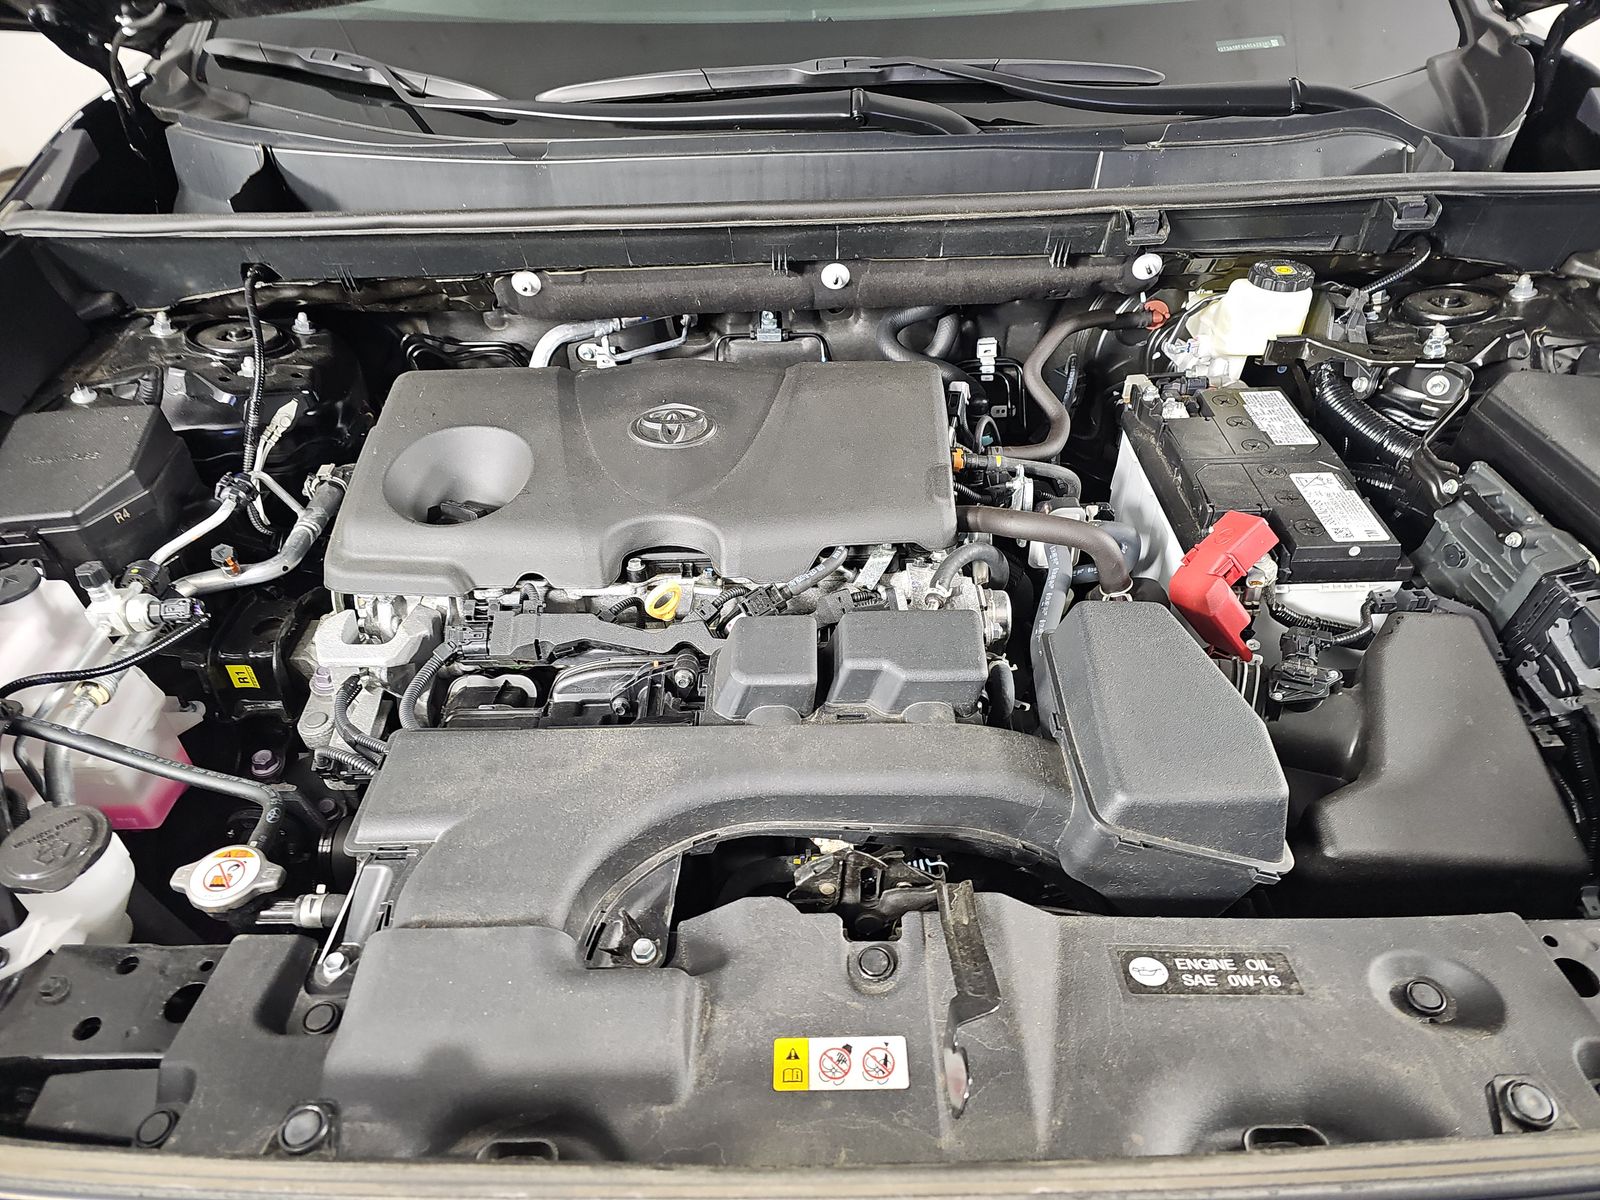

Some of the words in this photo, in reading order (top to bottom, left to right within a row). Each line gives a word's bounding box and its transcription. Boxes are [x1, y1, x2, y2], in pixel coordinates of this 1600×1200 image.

[1174, 958, 1237, 971] ENGINE
[1245, 959, 1275, 971] OIL
[1181, 974, 1218, 987] SAE
[1227, 975, 1282, 987] 0W-16
